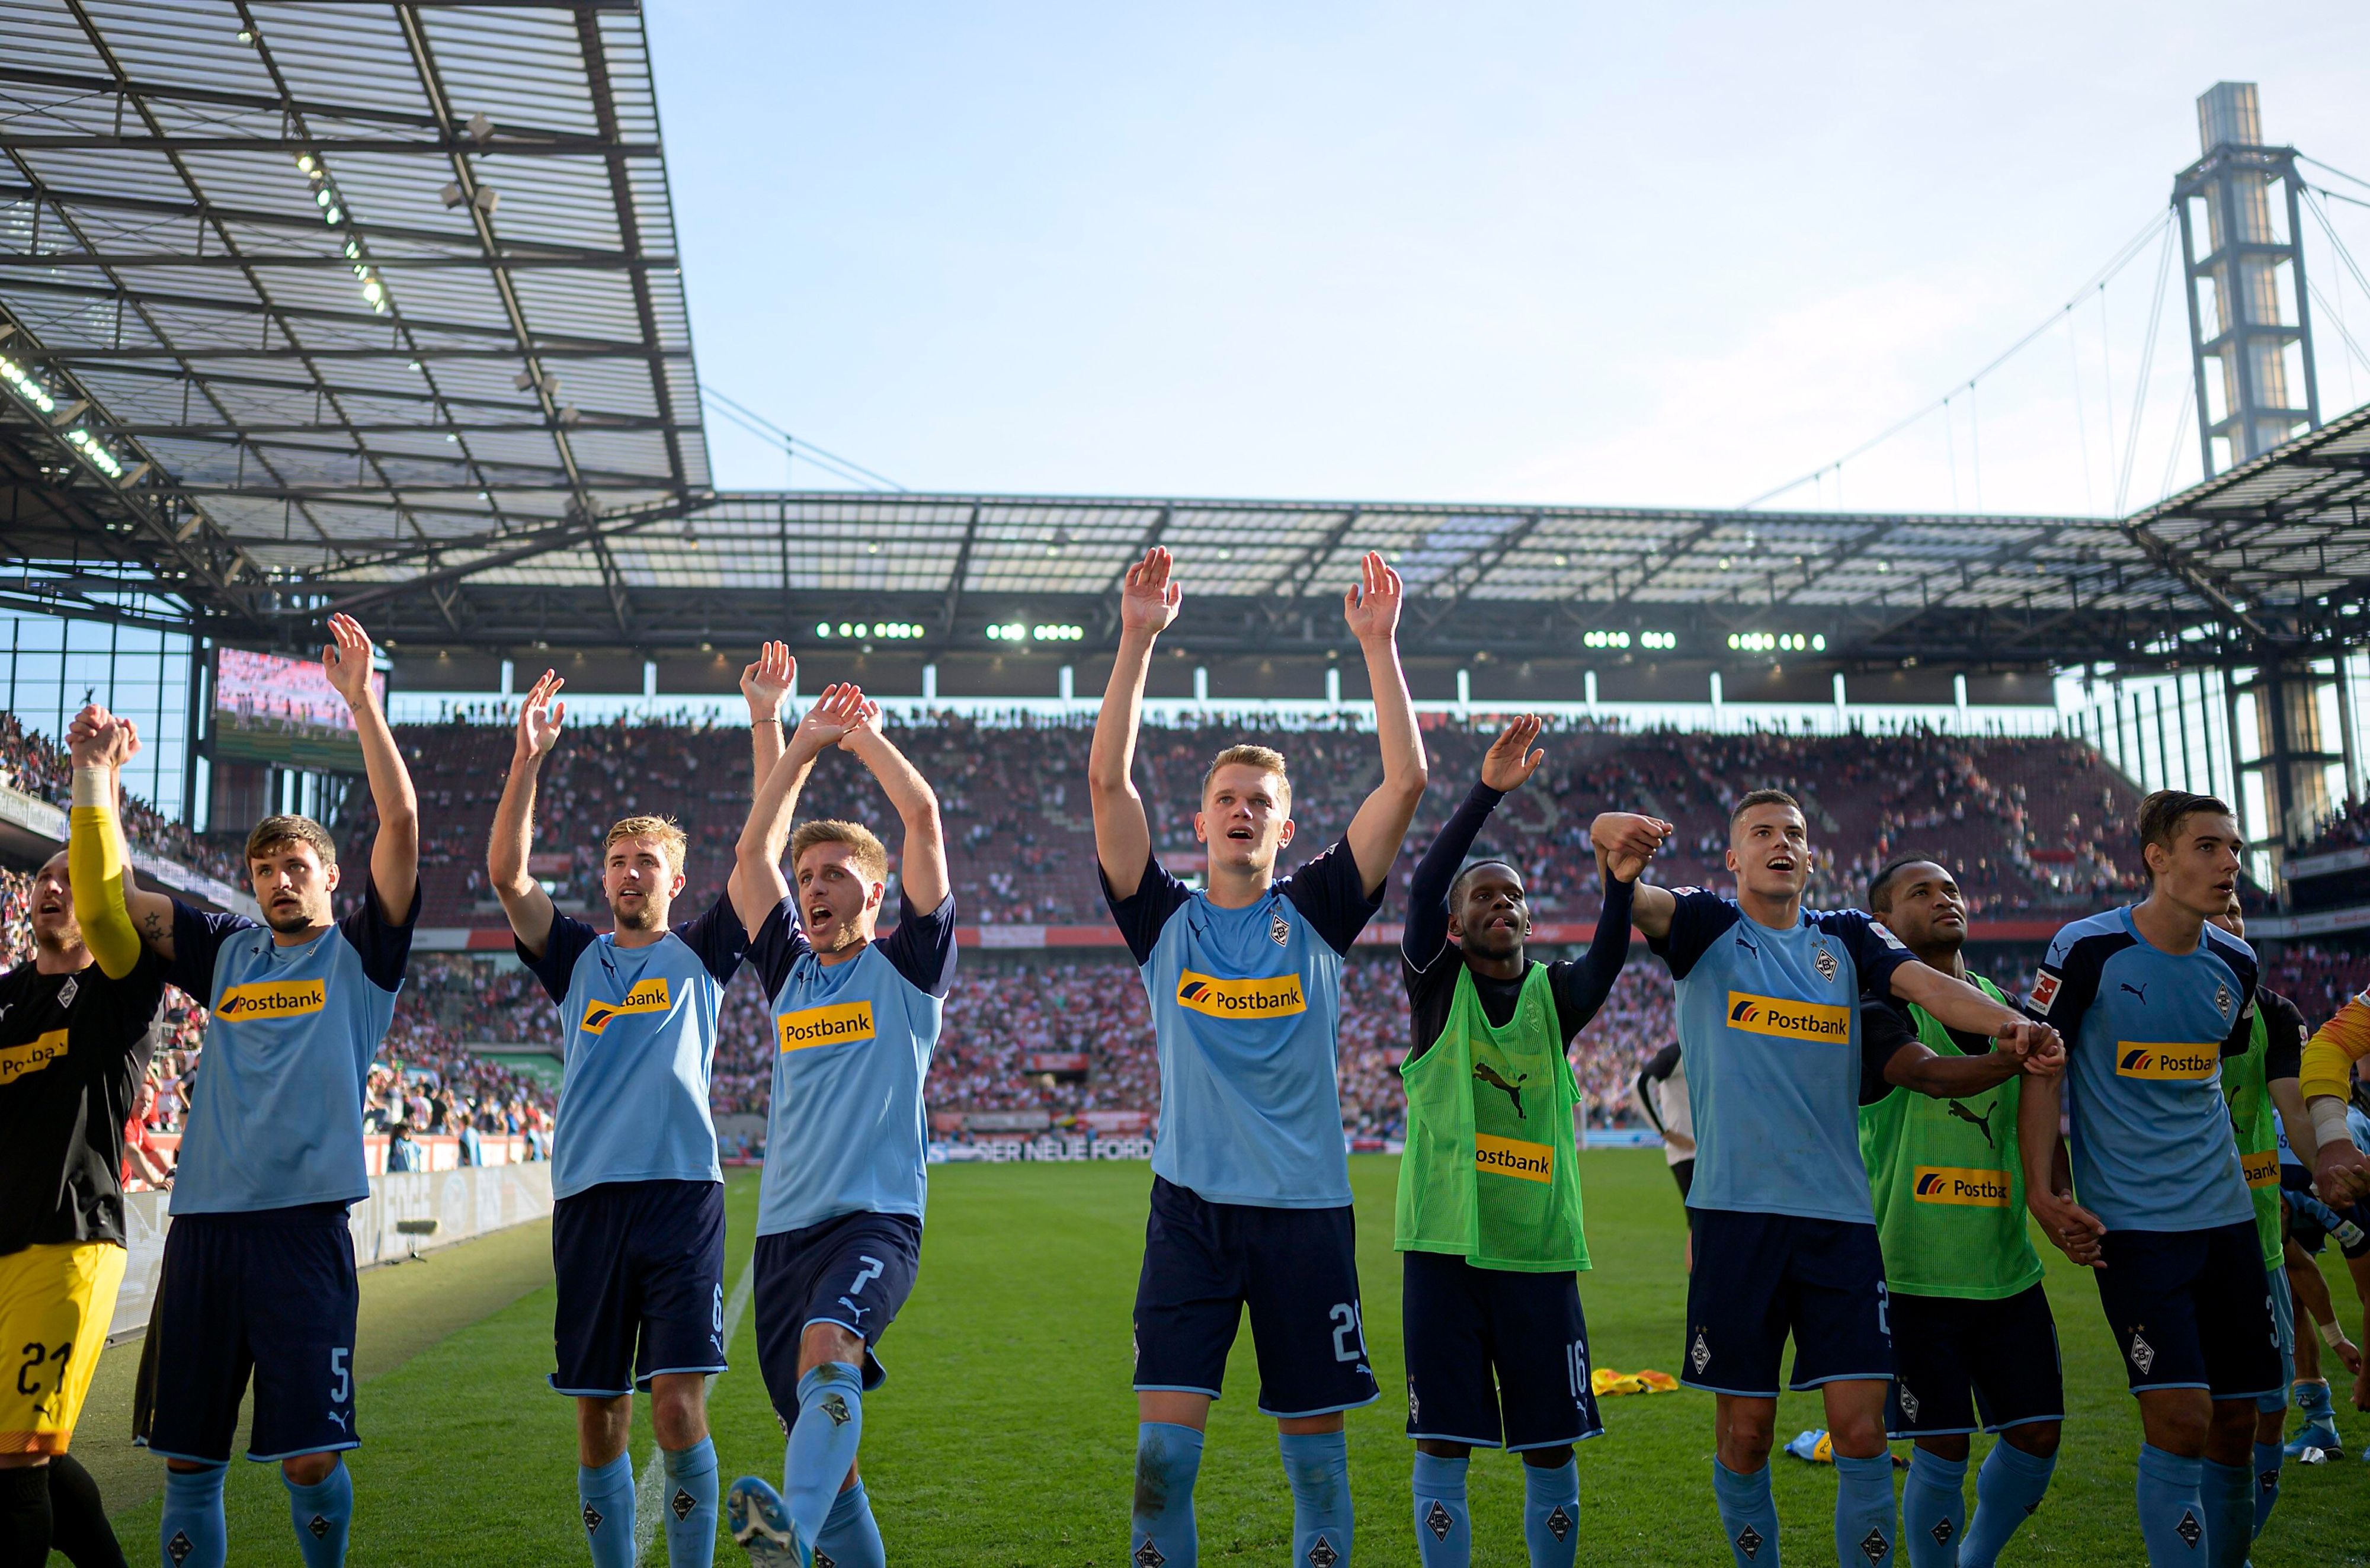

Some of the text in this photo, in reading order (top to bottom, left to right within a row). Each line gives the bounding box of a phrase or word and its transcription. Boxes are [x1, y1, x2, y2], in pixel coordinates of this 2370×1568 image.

[239, 990, 323, 1011] Postbank
[621, 989, 666, 1007] bank
[1217, 987, 1301, 1009] Postbank
[787, 1014, 870, 1042] Postbank
[1767, 1010, 1847, 1035] Postbank
[1024, 1140, 1089, 1162] NEUE
[1091, 1139, 1154, 1160] FORD
[1476, 1150, 1549, 1174] ostbank
[2243, 1161, 2278, 1181] bank
[850, 1255, 885, 1294] 7
[713, 1283, 722, 1332] 6
[18, 1342, 72, 1394] 21
[331, 1348, 348, 1403] 5
[1567, 1340, 1586, 1397] 16
